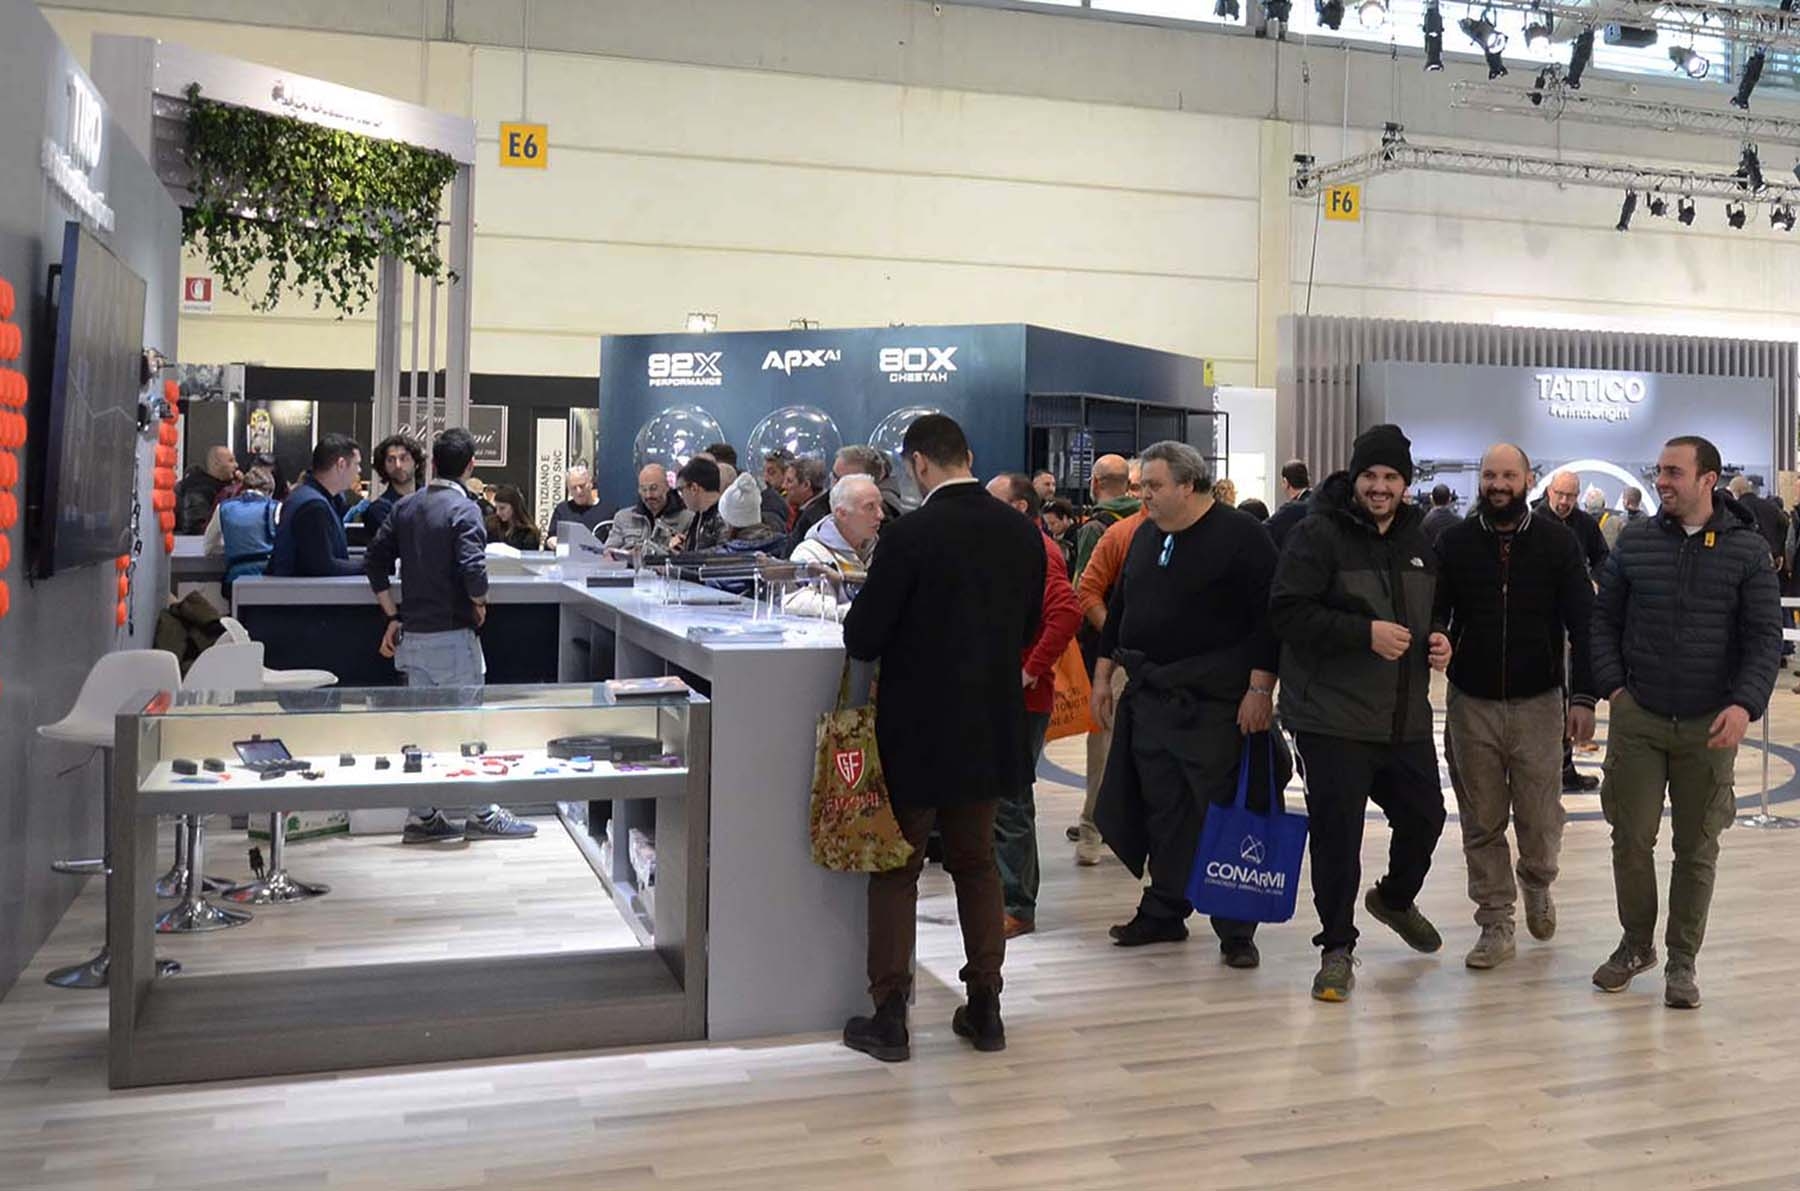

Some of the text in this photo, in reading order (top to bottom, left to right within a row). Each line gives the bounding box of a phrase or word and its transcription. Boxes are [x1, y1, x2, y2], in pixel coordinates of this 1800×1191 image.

[508, 132, 538, 159] E6
[1332, 190, 1353, 213] F6
[648, 352, 723, 378] 92X
[879, 347, 959, 372] 80X
[649, 377, 722, 387] PERFORMANCE
[889, 372, 949, 383] CHEETAH
[1535, 374, 1646, 404] TATTICO
[553, 449, 562, 473] SNC
[540, 463, 549, 506] TIZIANO
[1205, 861, 1286, 889] CONARMI
